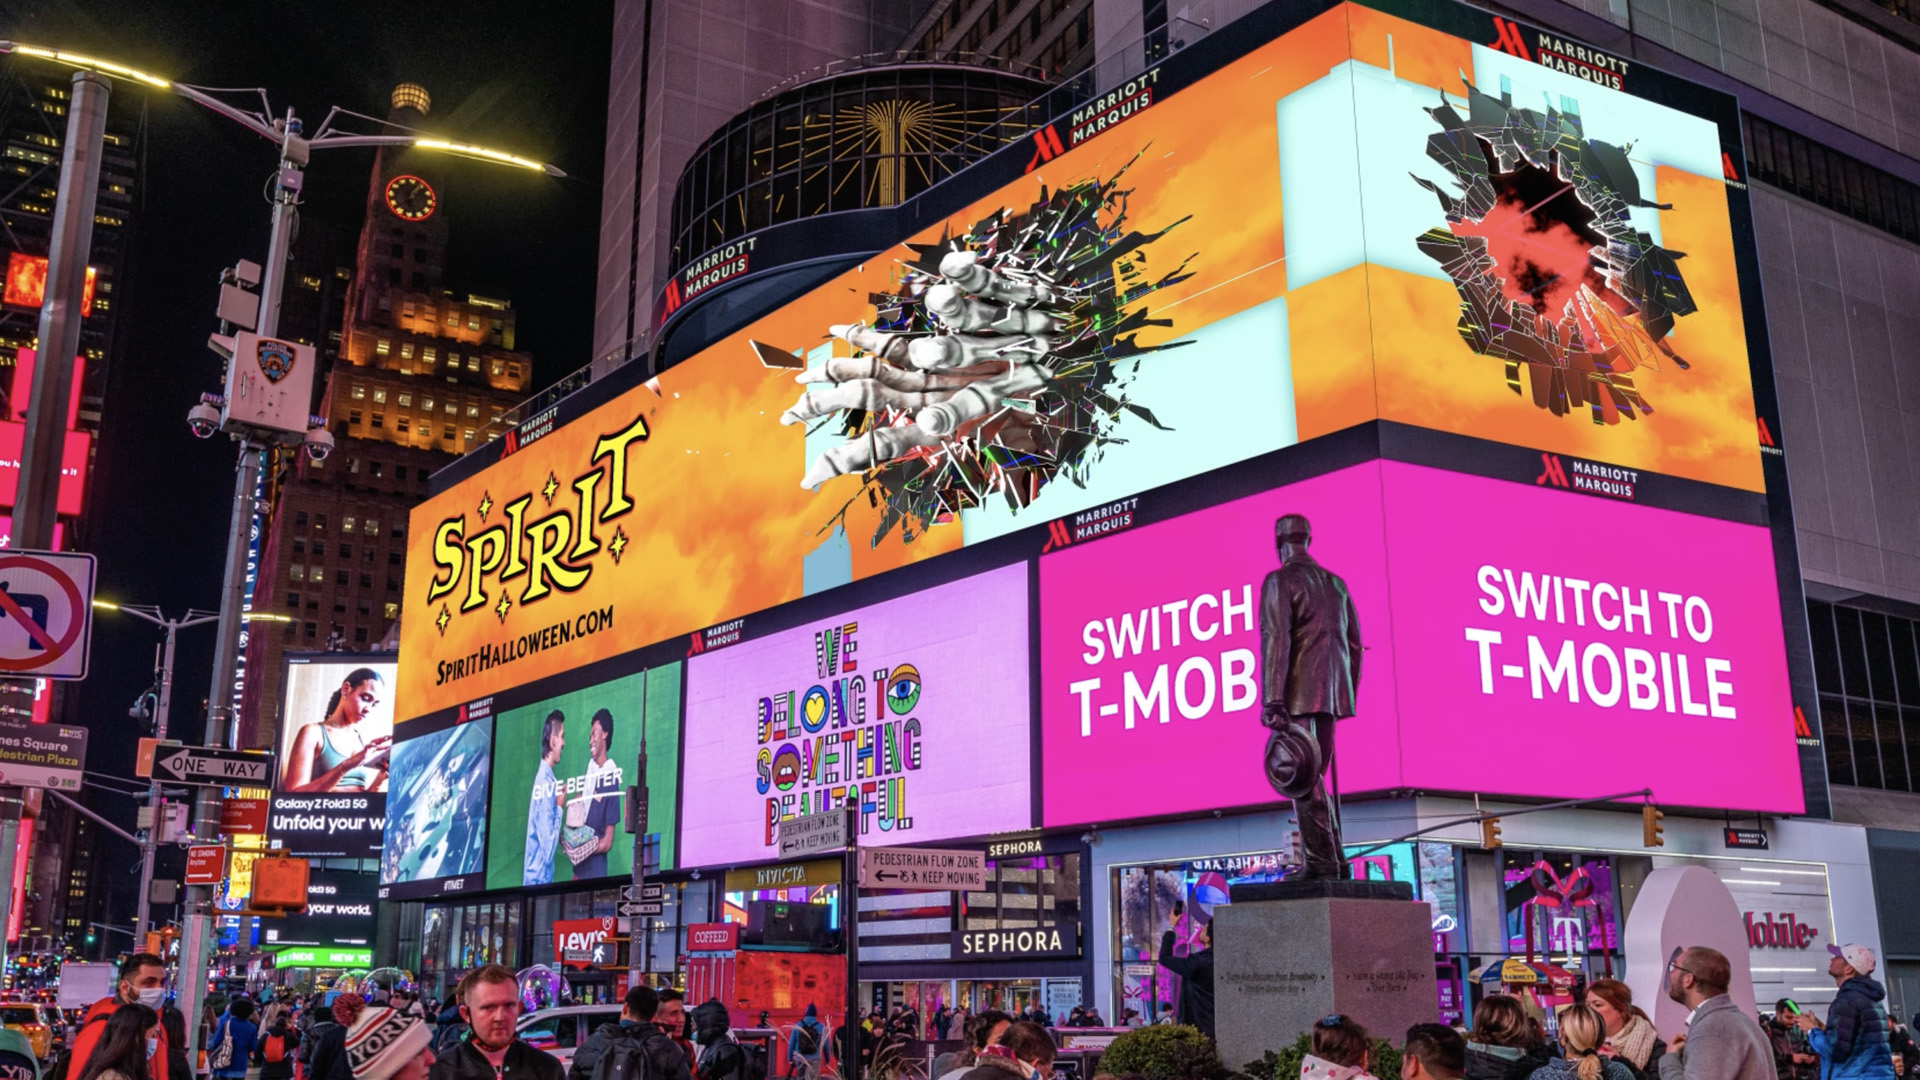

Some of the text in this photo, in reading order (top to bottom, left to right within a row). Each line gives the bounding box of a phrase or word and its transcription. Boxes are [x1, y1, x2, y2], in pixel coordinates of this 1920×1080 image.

[1538, 34, 1628, 75] MARRIOTT
[1541, 52, 1621, 90] MARQUIS
[1071, 67, 1160, 126] MARRIOTT
[1072, 92, 1152, 146] MARQUIS
[686, 238, 757, 280] MARRIOTT
[685, 259, 747, 298] MARQUIS
[520, 407, 558, 434] MARRIOTT
[519, 422, 553, 447] MARQUIS
[1573, 461, 1638, 484] MARRIOTT
[1575, 476, 1632, 497] MARQUIS
[427, 413, 651, 615] SPIRIT
[1076, 498, 1138, 526] MARRIOTT
[1076, 514, 1132, 540] MARQUIS
[1477, 565, 1713, 643] SWITCH TO
[707, 619, 745, 637] MARRIOTT
[1082, 584, 1254, 665] SWITCH
[706, 631, 740, 648] MARQUIS
[815, 621, 858, 679] WE
[1465, 627, 1737, 720] T-MOBILE
[758, 663, 921, 745] BELONG TO
[1069, 648, 1258, 738] T-MOB
[23, 737, 68, 752] Square
[756, 717, 921, 795] SOMETHING
[47, 753, 78, 766] Plaza
[172, 757, 259, 777] ONE WAY
[533, 768, 623, 800] GIVE BETTER
[230, 802, 256, 810] STANDING
[275, 798, 368, 811] Galaxy Z Fold3 5G
[765, 776, 913, 846] BEAUTFUL
[272, 814, 325, 831] Unfold
[328, 818, 366, 834] your
[781, 813, 840, 838] PEDESTRIAN FLOW ZONE
[806, 830, 840, 849] KEEP MOVING
[989, 840, 1042, 856] SEPHORA
[190, 849, 217, 858] NO STANDING
[874, 852, 980, 868] PEDESTRIAN FLOW ZONE
[756, 865, 807, 886] INVICTA
[922, 872, 980, 885] KEEP MOVING
[308, 885, 337, 894] old3 5G
[308, 903, 334, 916] your
[624, 905, 637, 913] ONE
[694, 930, 729, 943] COFFEED
[963, 930, 1062, 954] SEPHORA
[330, 953, 355, 963] NEW
[357, 953, 371, 963] YO
[352, 1013, 414, 1062] YORK
